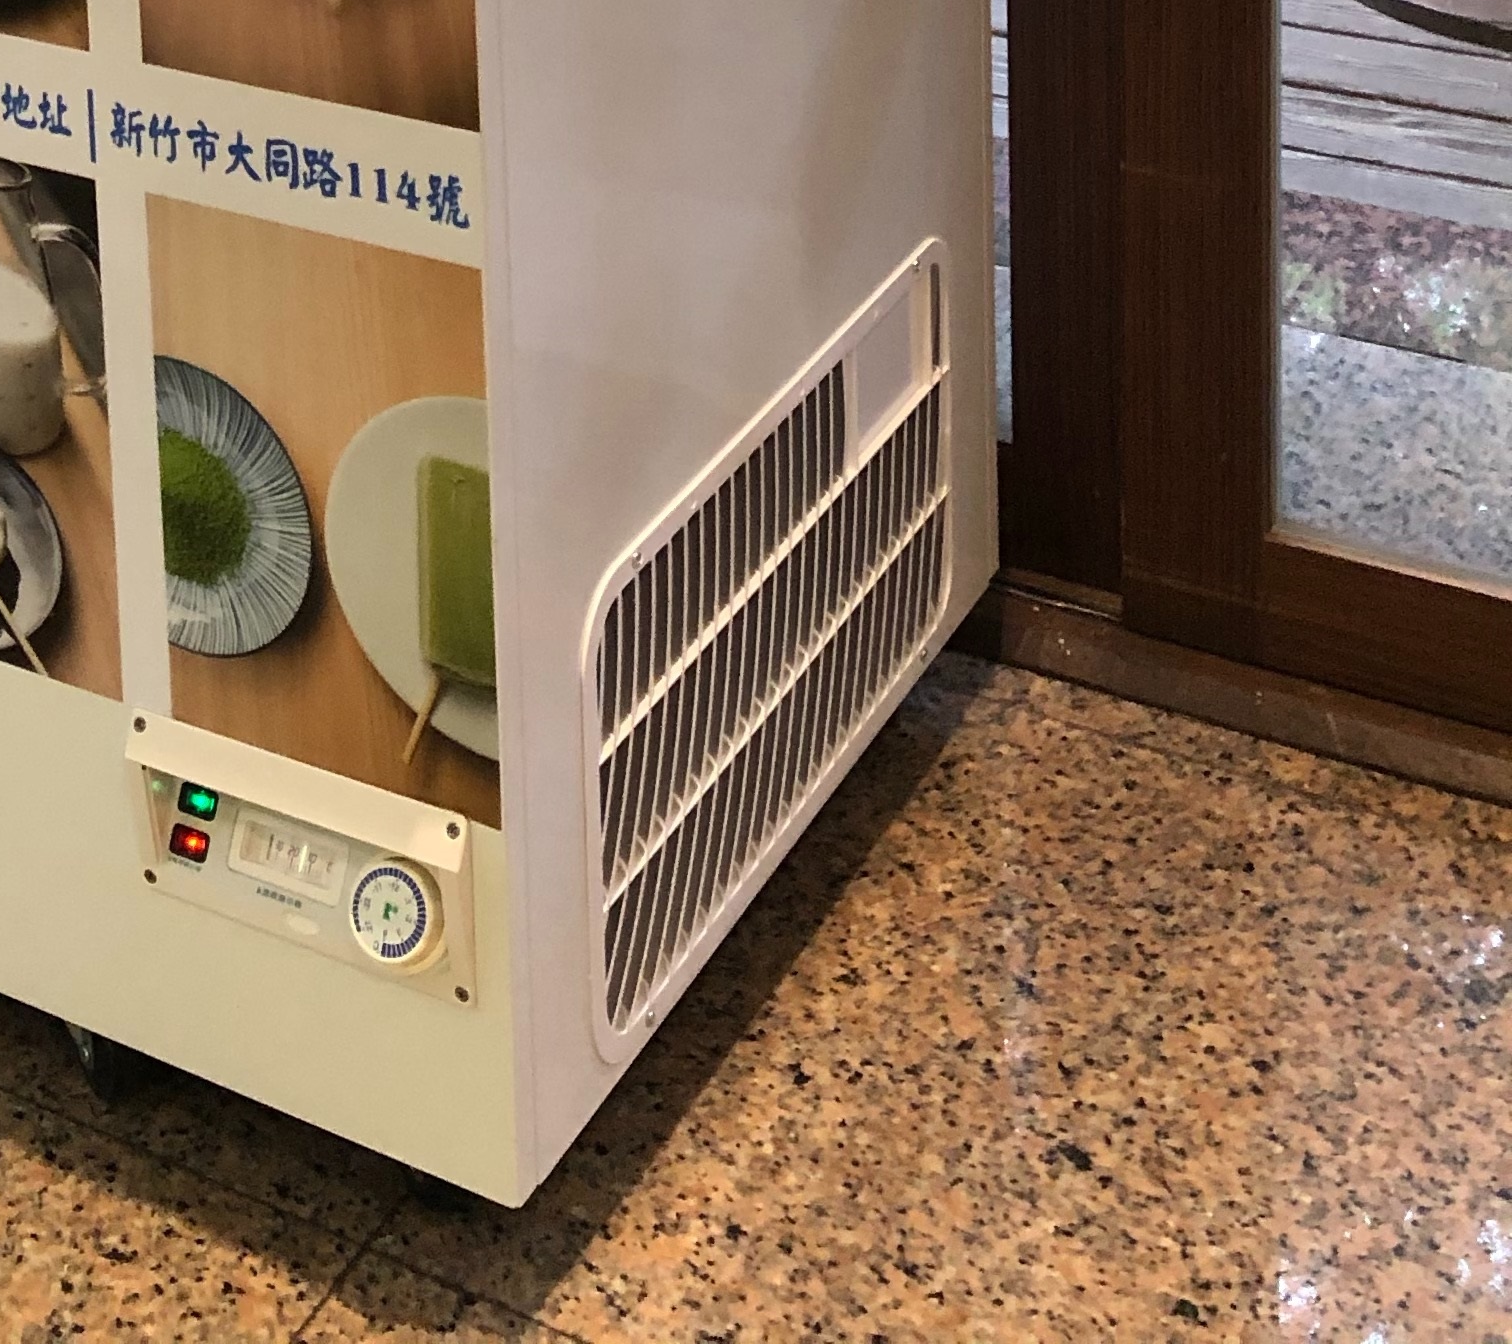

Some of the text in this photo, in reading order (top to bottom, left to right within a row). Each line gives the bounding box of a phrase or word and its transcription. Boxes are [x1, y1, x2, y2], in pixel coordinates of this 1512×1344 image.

[110, 102, 471, 230] 新竹市大同路114號
